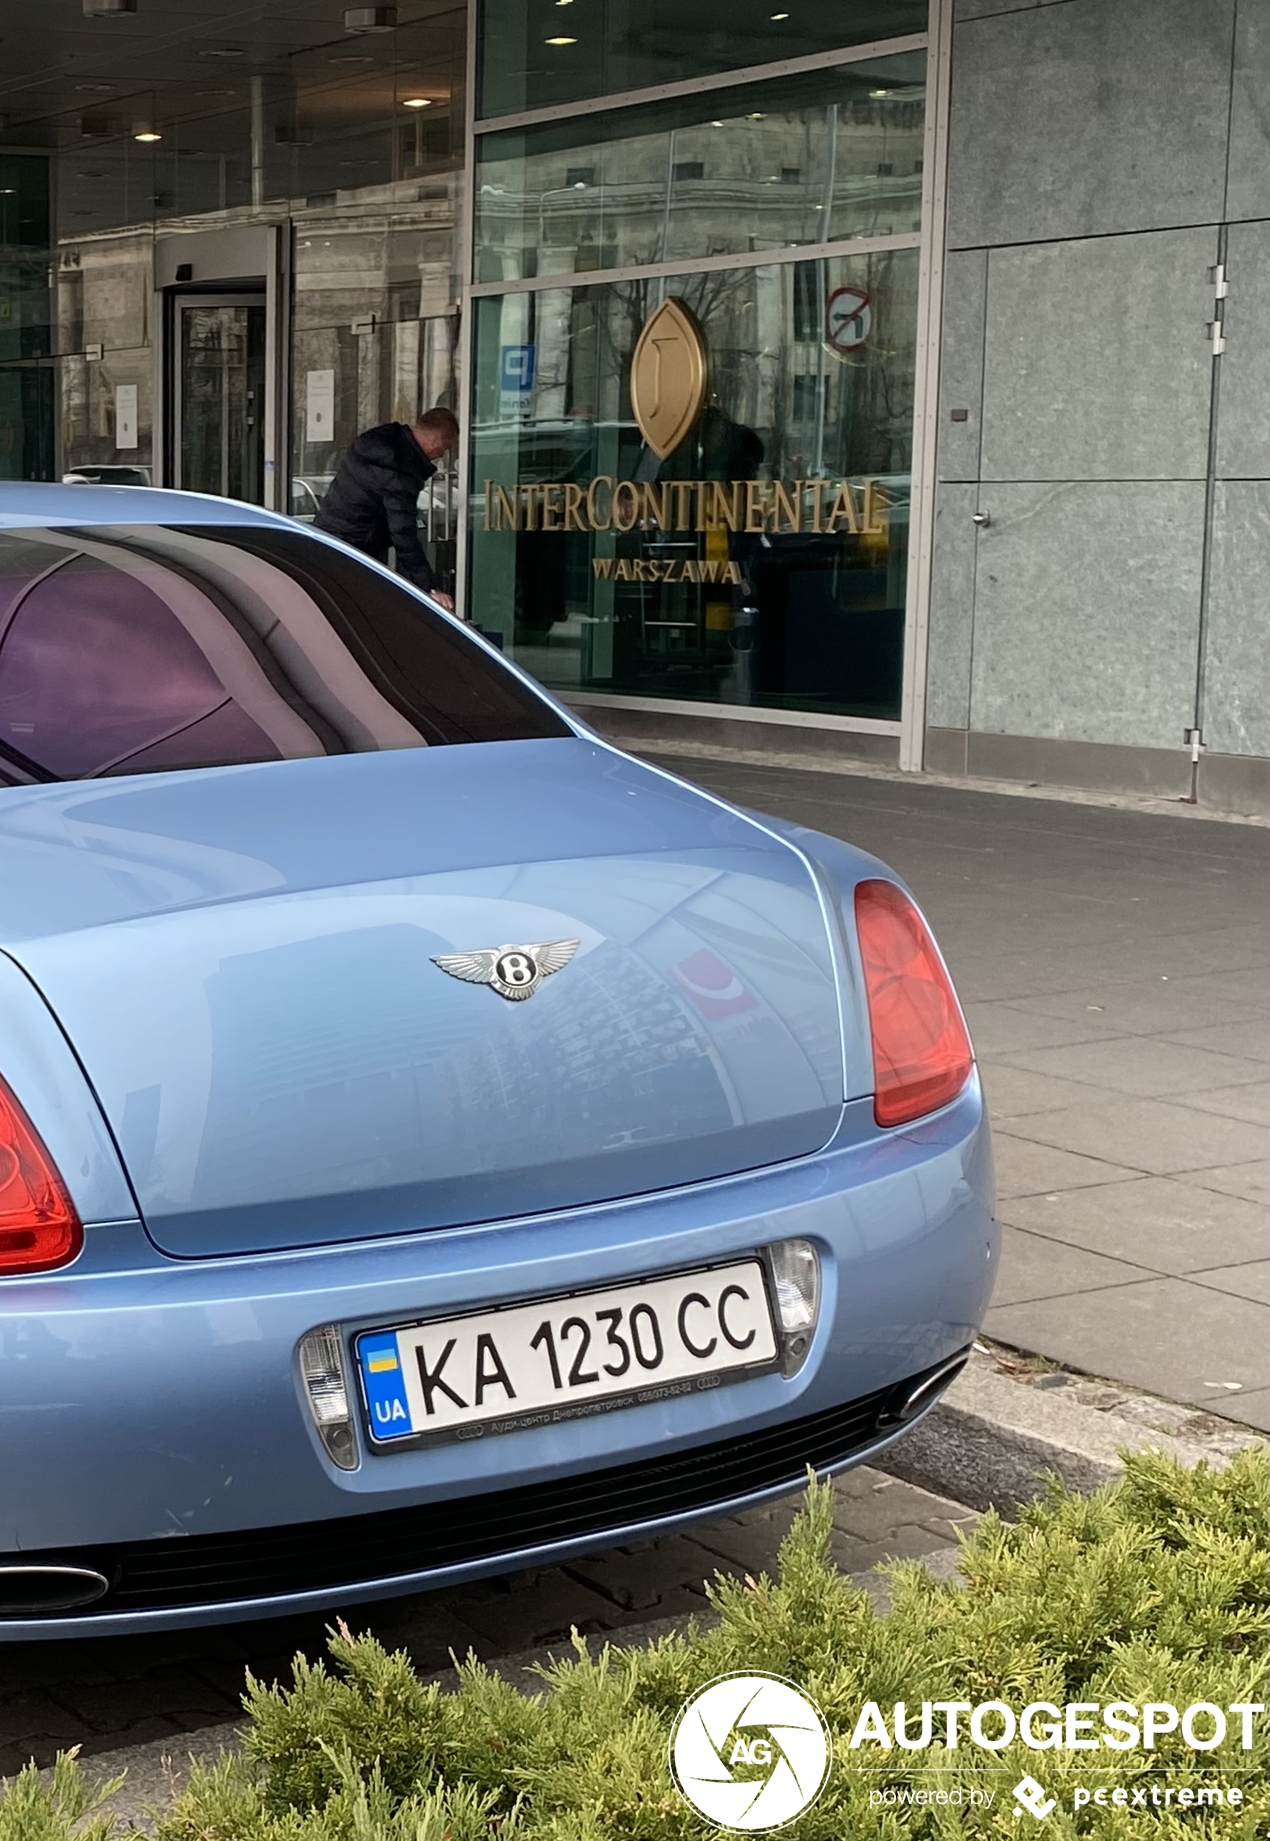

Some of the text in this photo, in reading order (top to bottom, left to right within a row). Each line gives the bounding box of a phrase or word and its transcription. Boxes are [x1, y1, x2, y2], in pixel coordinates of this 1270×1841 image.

[593, 558, 742, 585] WARSZAWA
[415, 1284, 757, 1415] KA 1230 CC
[376, 1397, 407, 1423] UA
[552, 1394, 634, 1422] Днепропетровск
